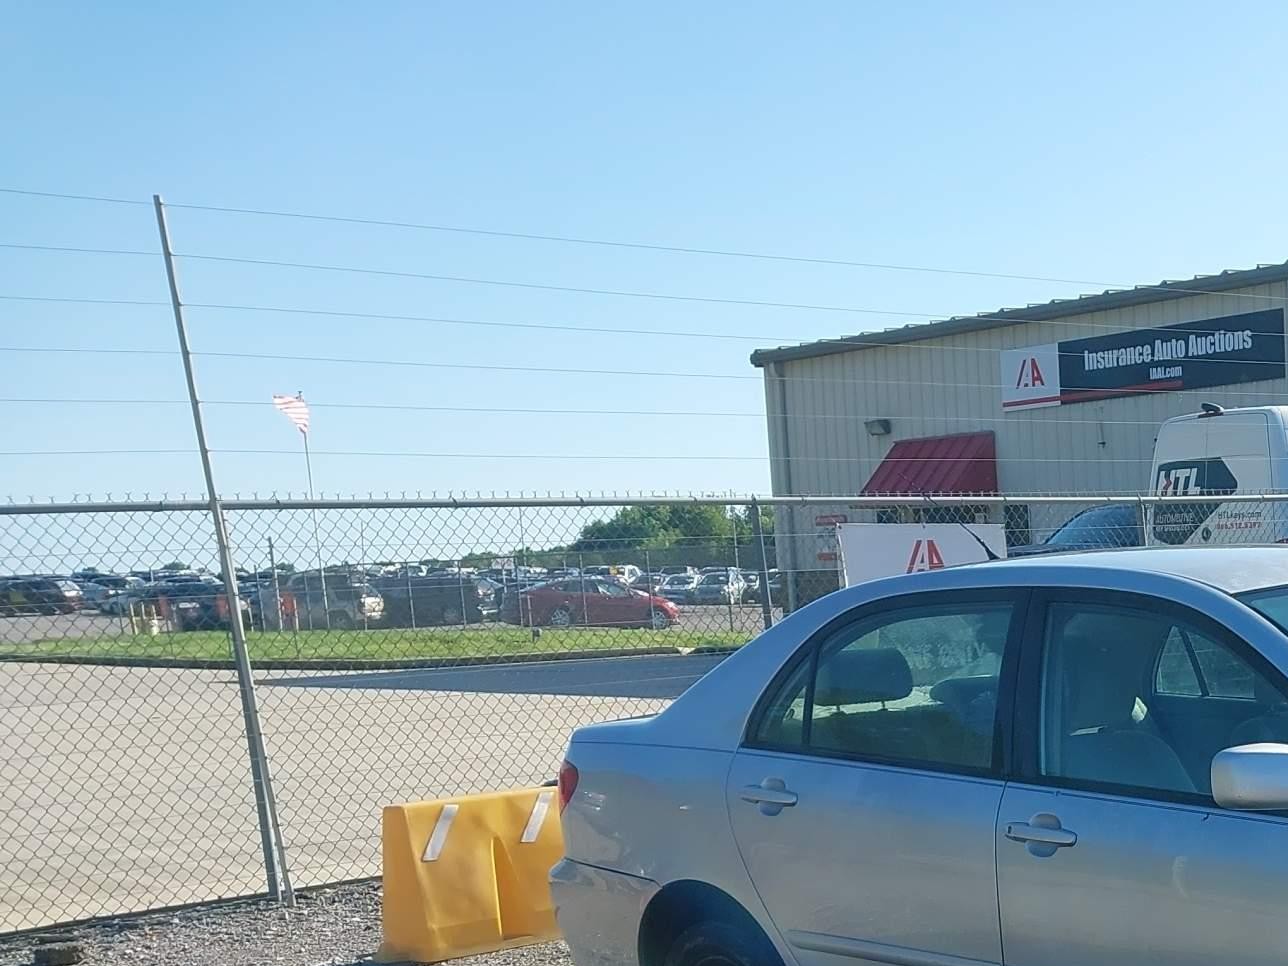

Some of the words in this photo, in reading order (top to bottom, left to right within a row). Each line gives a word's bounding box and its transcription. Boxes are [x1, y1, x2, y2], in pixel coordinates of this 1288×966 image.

[1084, 344, 1151, 371] Insurance
[1154, 338, 1186, 361] Auto
[1189, 330, 1252, 356] Auctions
[1150, 366, 1182, 379] IAAI.com
[1155, 513, 1194, 524] AUTOMOTIVE
